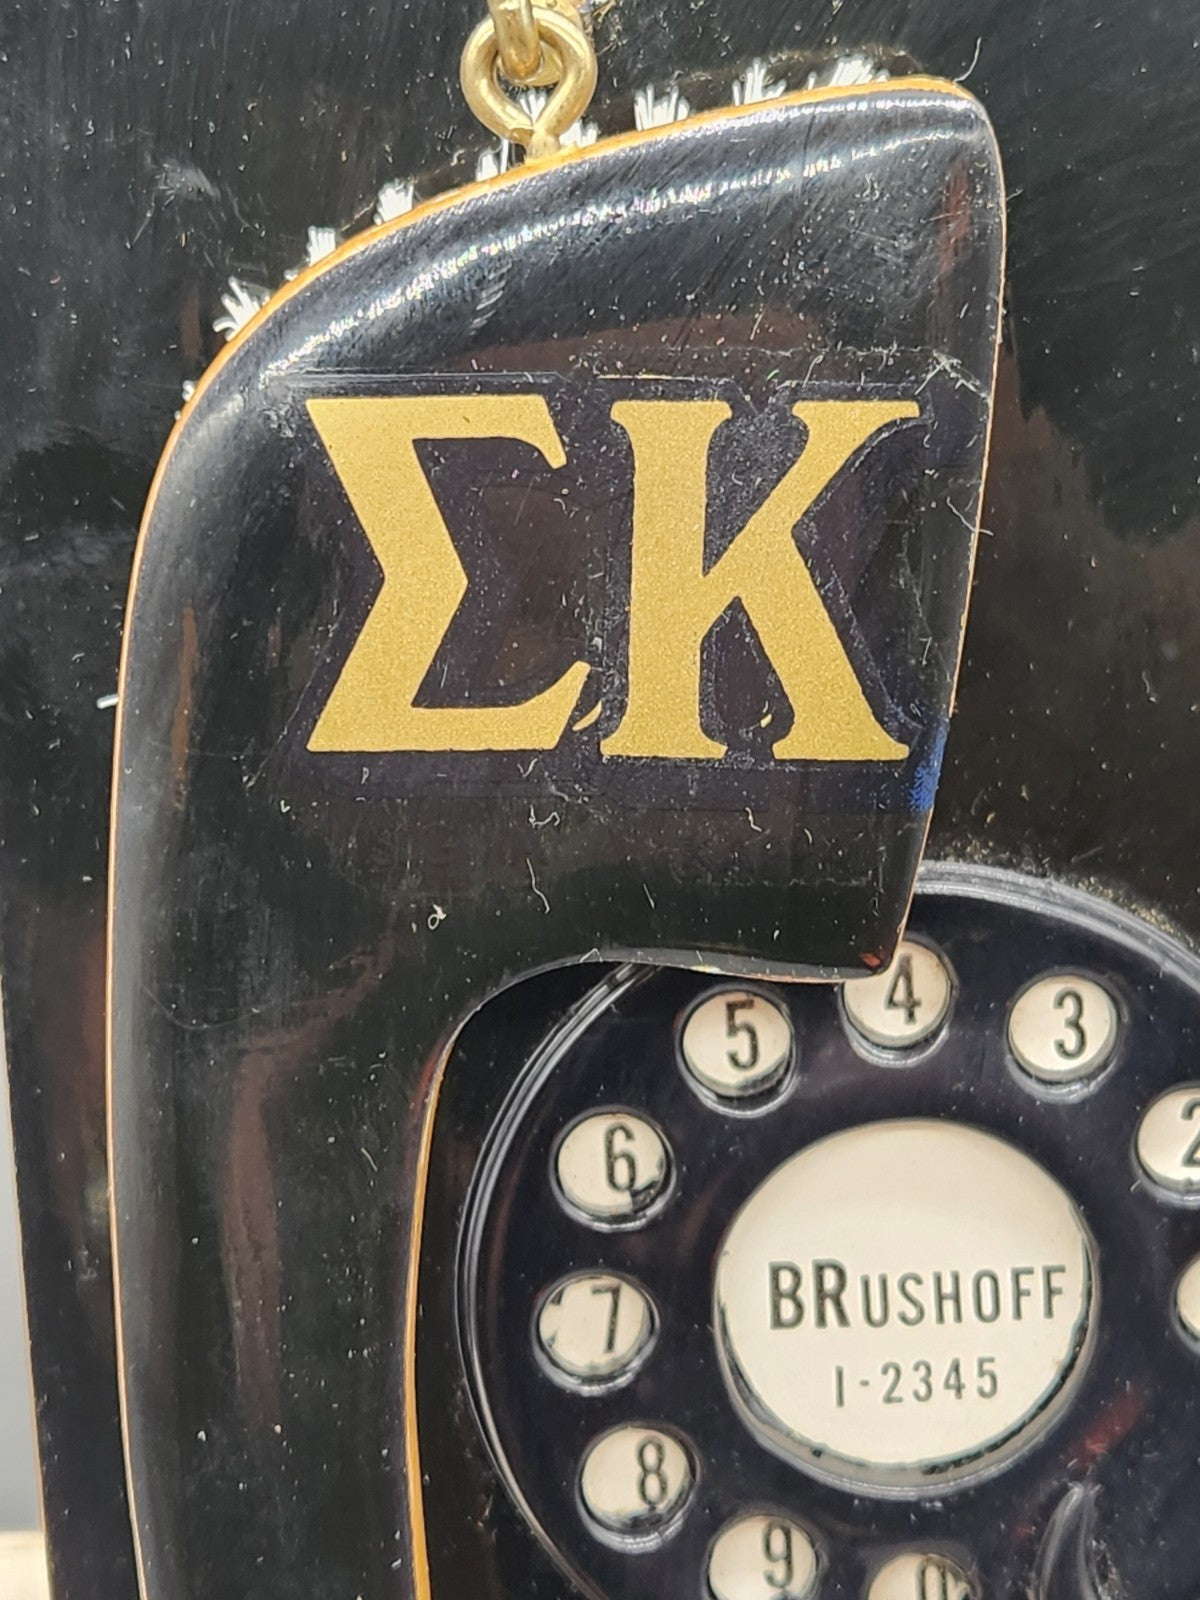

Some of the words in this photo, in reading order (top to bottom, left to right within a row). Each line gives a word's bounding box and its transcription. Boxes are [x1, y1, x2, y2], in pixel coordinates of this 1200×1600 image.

[884, 953, 921, 1025] 4
[1053, 988, 1087, 1060] 3
[726, 998, 759, 1070] 5
[604, 1122, 637, 1191] 6
[591, 1283, 621, 1354] 7
[768, 1258, 1066, 1330] BRUSHOFF
[636, 1439, 667, 1506] 8
[763, 1521, 793, 1588] 9
